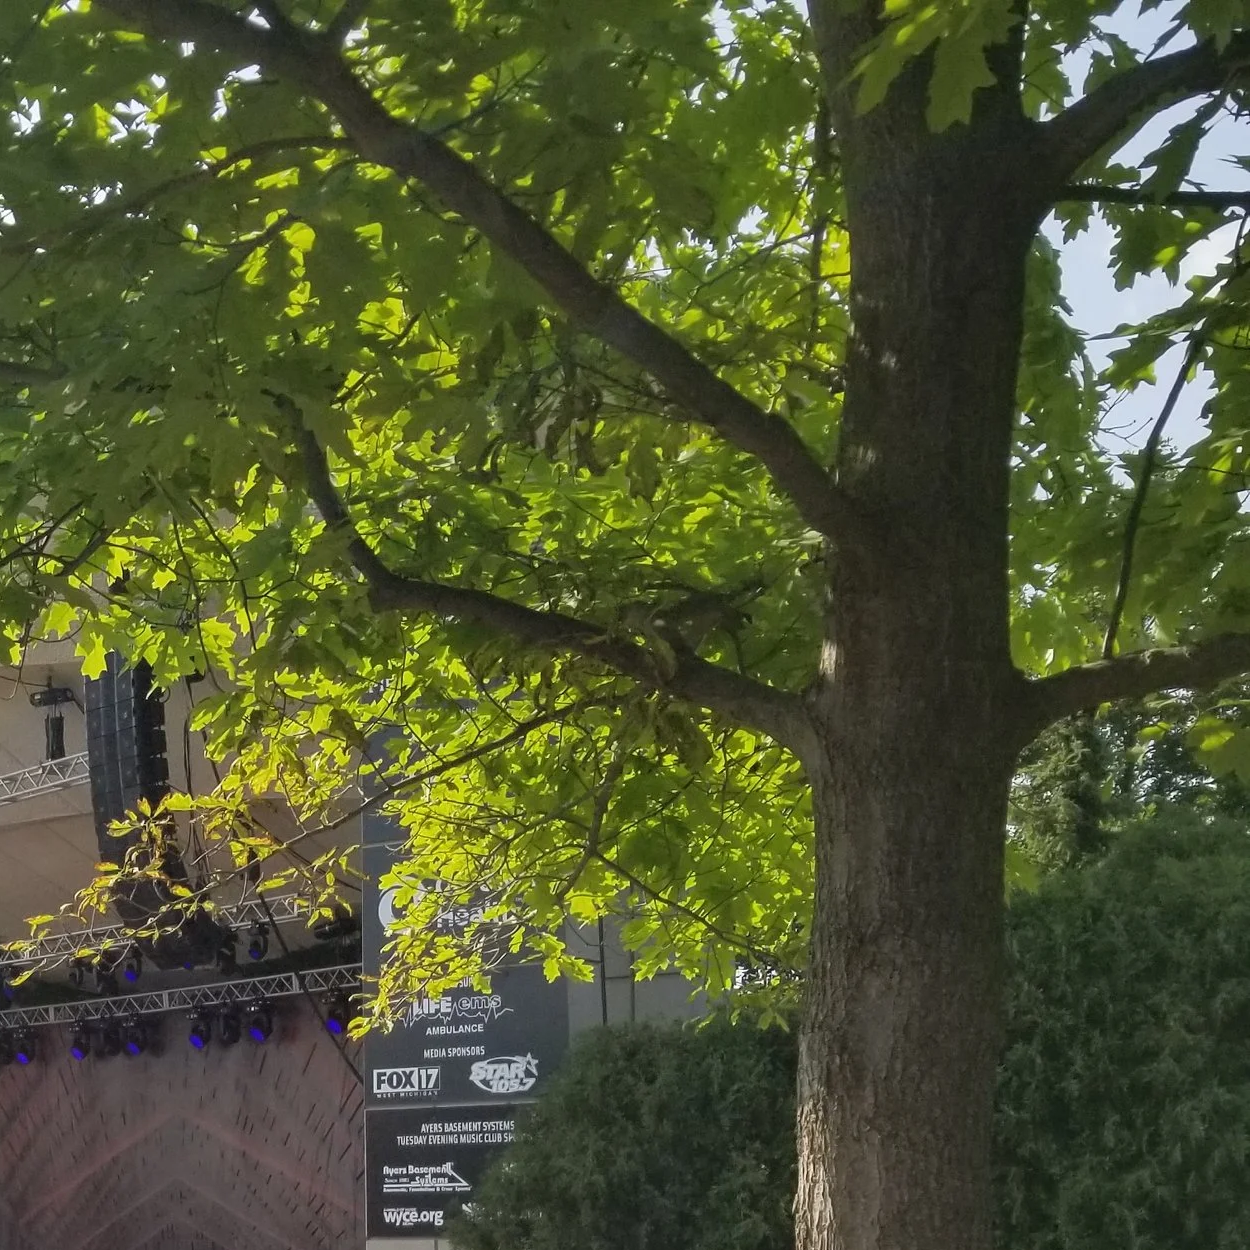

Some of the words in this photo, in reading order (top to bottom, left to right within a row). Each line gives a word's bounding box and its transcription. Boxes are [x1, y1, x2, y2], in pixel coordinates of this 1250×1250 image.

[413, 997, 451, 1015] LIFE
[458, 995, 501, 1010] ems
[425, 1024, 484, 1035] AMBULANCE
[423, 1048, 446, 1058] MEDIA
[447, 1046, 485, 1057] SPONSORS
[470, 1061, 526, 1081] STAR
[376, 1070, 416, 1090] FOX
[419, 1068, 440, 1089] 17
[490, 1078, 536, 1093] 105.7
[420, 1122, 443, 1134] AYERS
[444, 1121, 481, 1133] BASEMENT
[482, 1120, 515, 1131] SYSTEMS
[397, 1135, 427, 1146] TUESDAY
[428, 1134, 458, 1145] EVENING
[459, 1133, 483, 1144] MUSIC
[484, 1132, 502, 1143] CLUB
[383, 1210, 444, 1226] wyce.org
